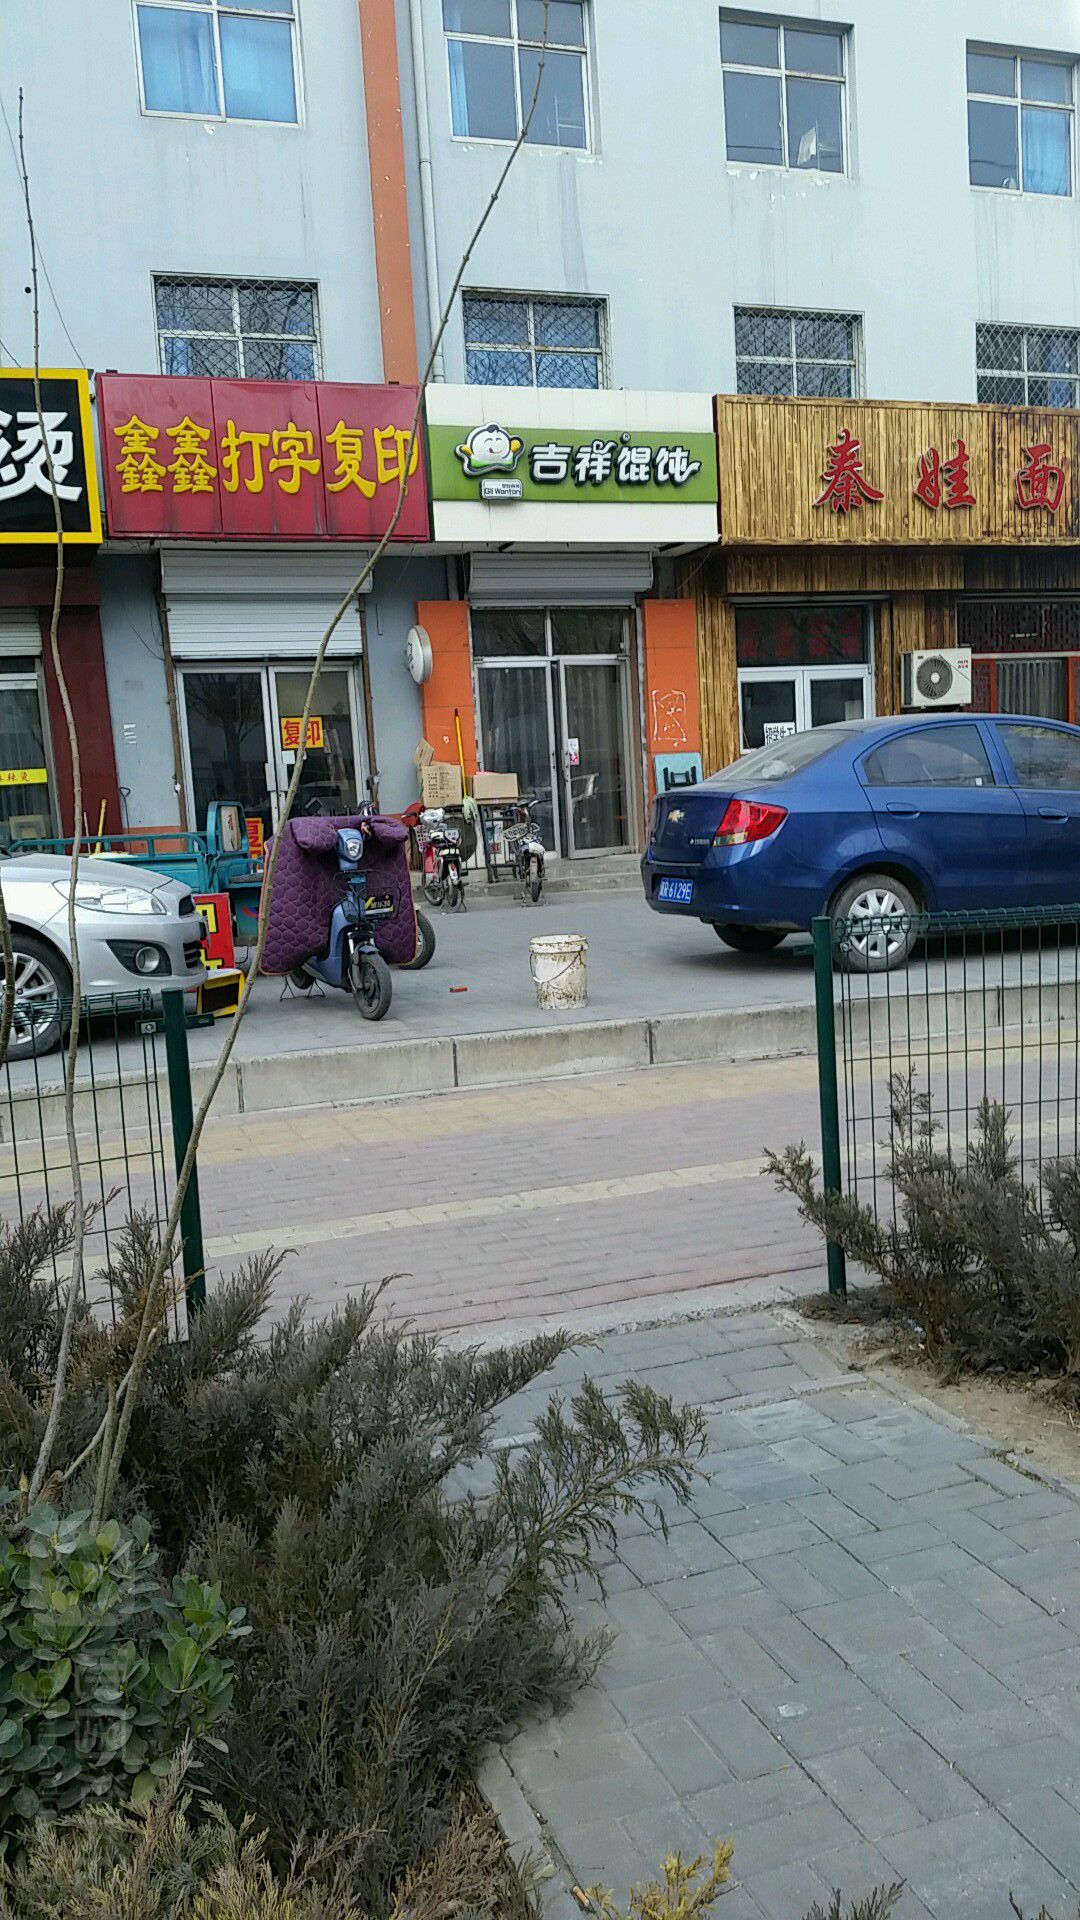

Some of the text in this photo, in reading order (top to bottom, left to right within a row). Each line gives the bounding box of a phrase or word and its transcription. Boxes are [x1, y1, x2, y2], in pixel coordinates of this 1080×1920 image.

[0, 410, 82, 502] 烫
[113, 415, 419, 499] 鑫鑫打字复印
[531, 440, 702, 485] 吉祥馄饨
[284, 720, 321, 746] 复印
